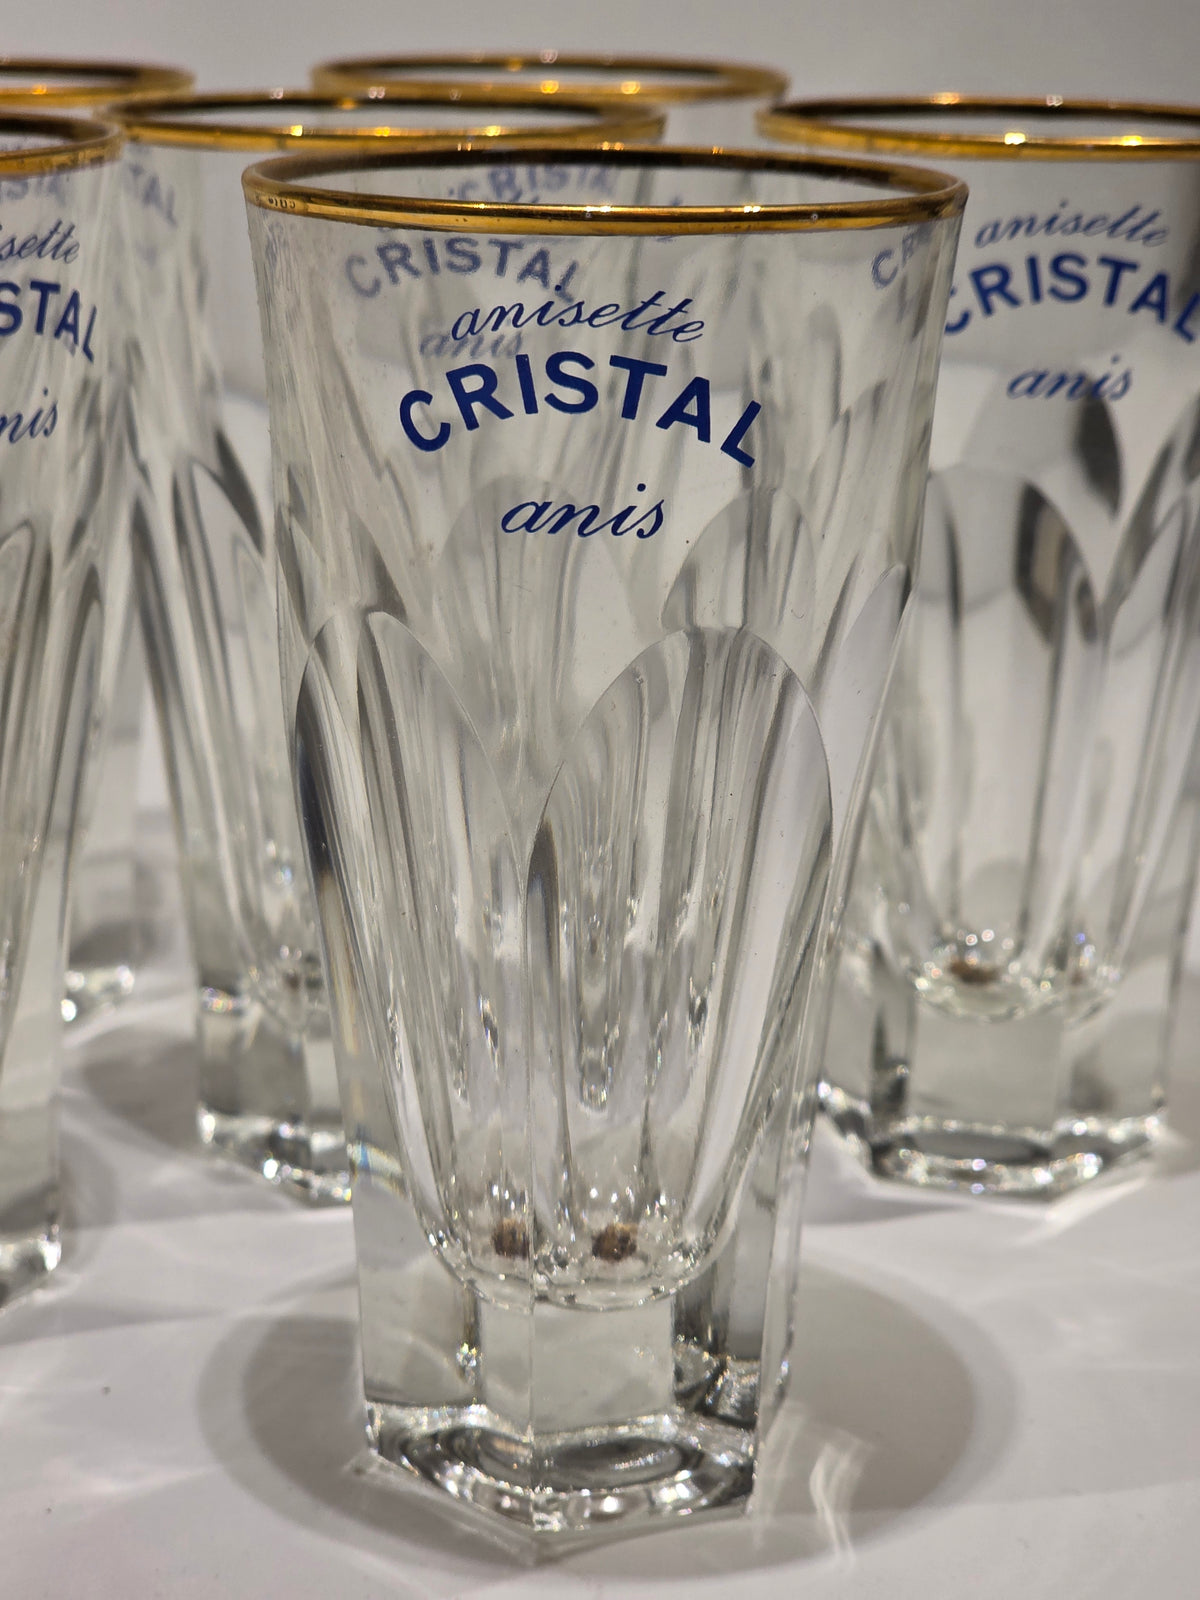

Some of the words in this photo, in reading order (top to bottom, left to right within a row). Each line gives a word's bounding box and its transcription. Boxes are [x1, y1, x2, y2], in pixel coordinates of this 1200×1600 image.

[0, 219, 81, 265] sette
[974, 200, 1170, 248] anisette
[344, 236, 581, 303] CRISTAL
[451, 285, 705, 342] anisette
[1007, 355, 1134, 401] anis
[399, 350, 761, 468] CRISTAL
[501, 483, 665, 539] anis
